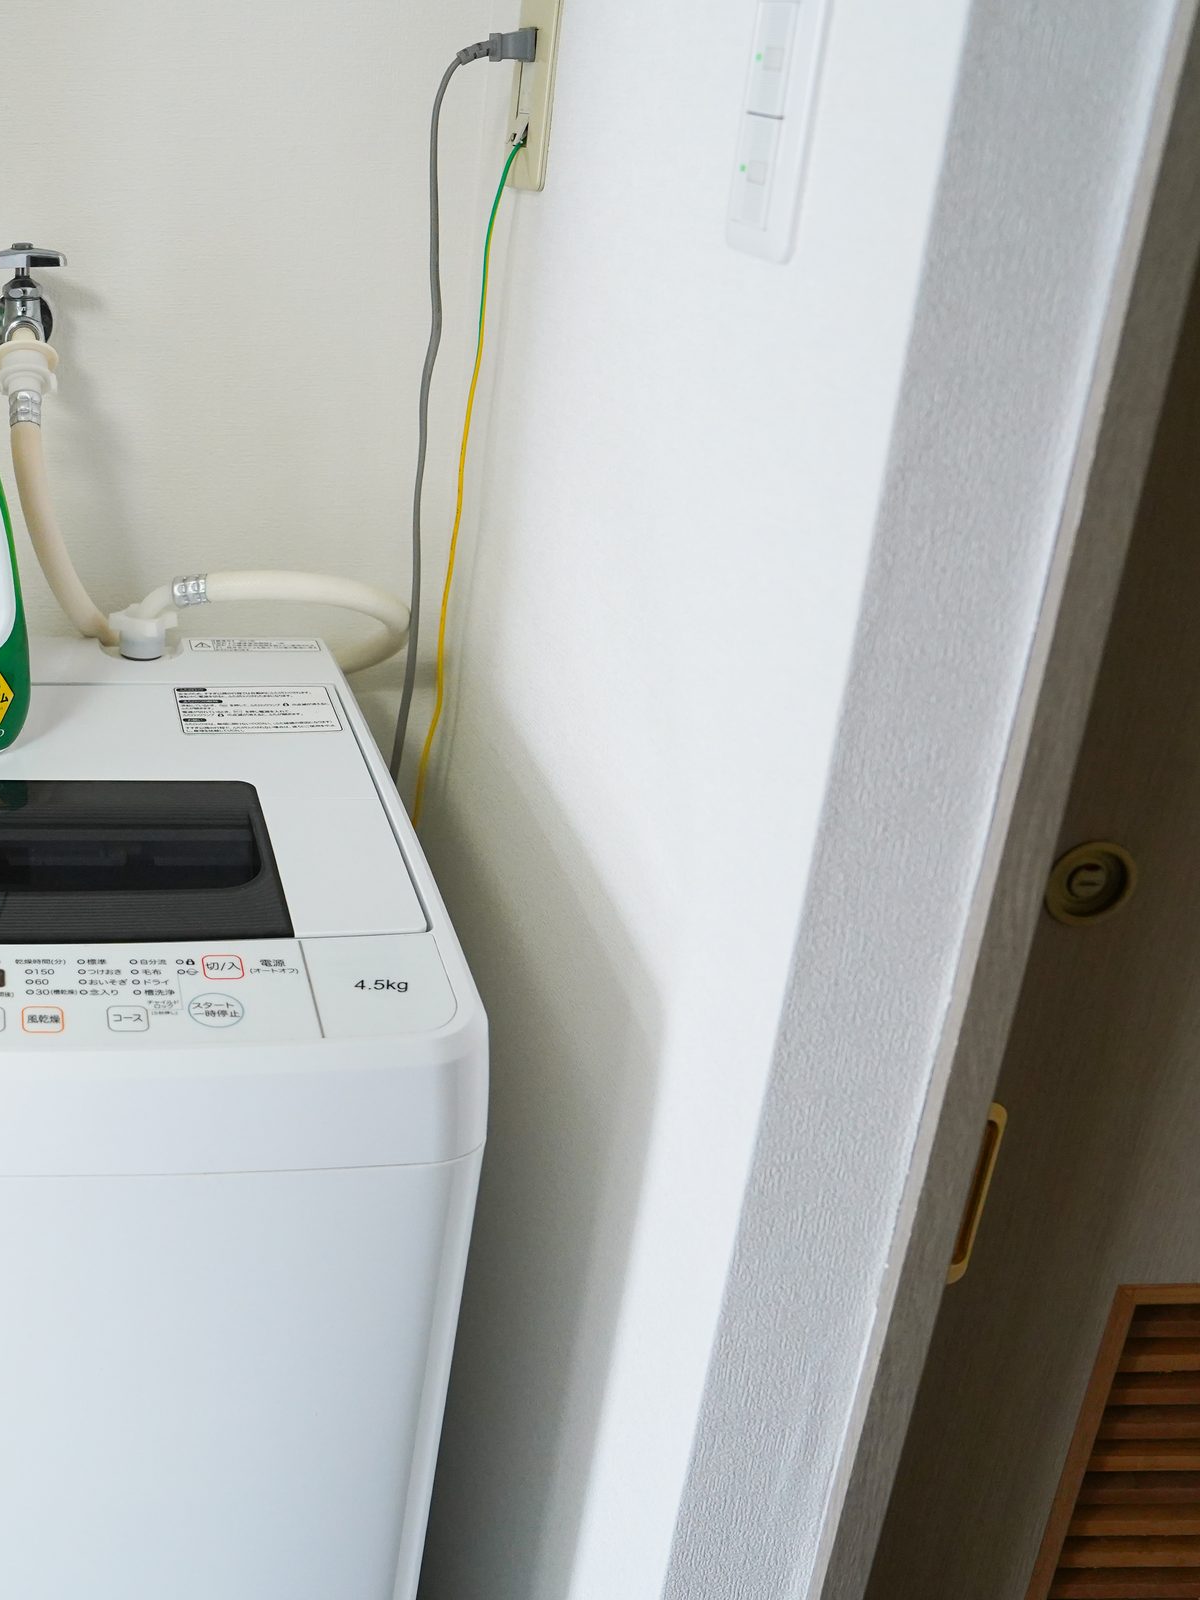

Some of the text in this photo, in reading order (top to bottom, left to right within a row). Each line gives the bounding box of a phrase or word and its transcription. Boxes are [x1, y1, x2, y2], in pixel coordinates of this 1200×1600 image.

[206, 961, 241, 971] 切/入
[260, 959, 286, 967] 電源
[354, 979, 409, 992] 4.5kg
[112, 1014, 143, 1022] コース
[193, 1009, 241, 1018] 一時停止
[27, 1014, 61, 1024] 風乾燥
